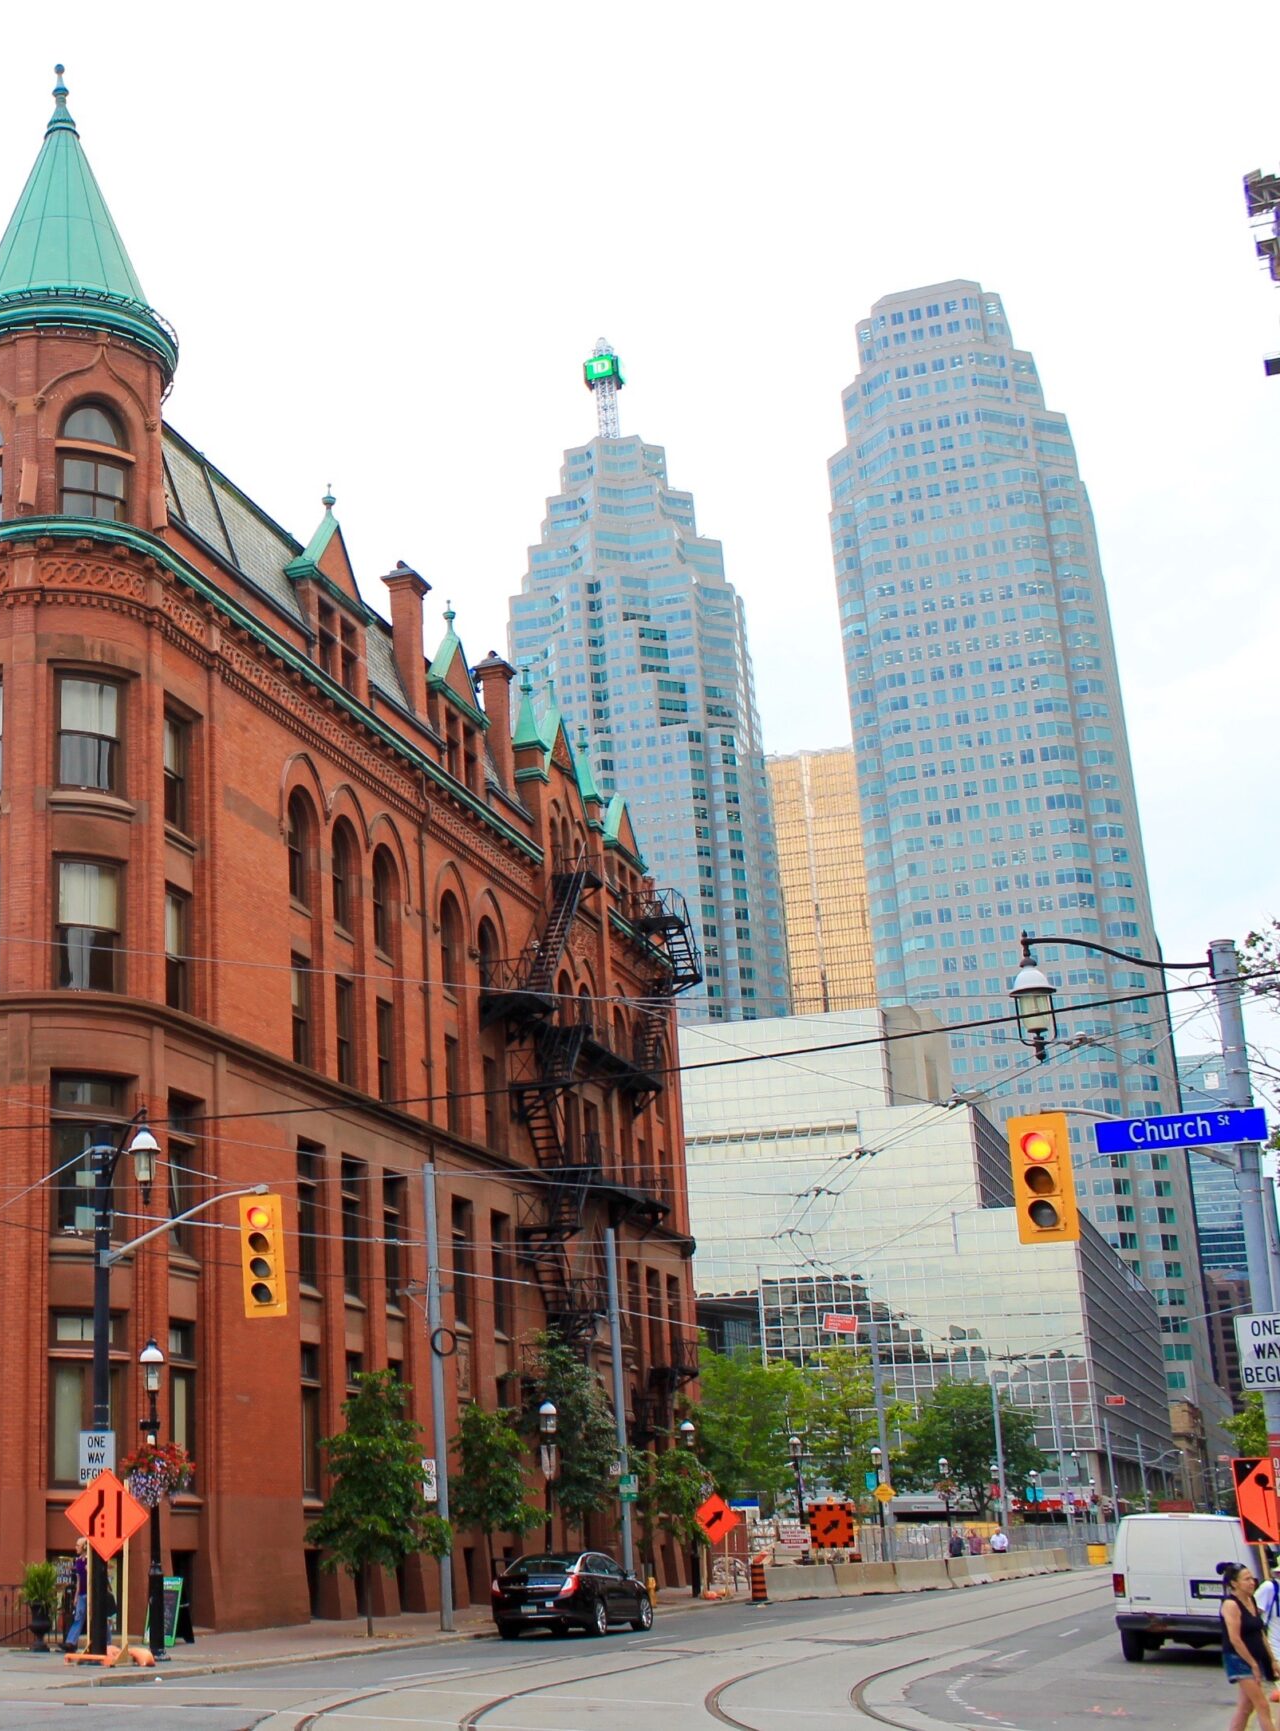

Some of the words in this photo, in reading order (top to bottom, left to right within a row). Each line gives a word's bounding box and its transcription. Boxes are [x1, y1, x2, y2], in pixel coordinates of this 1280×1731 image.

[1129, 1116, 1211, 1143] Church
[1217, 1114, 1230, 1126] St
[1251, 1320, 1280, 1336] ONE
[87, 1435, 106, 1448] ONE
[88, 1452, 105, 1464] WAY
